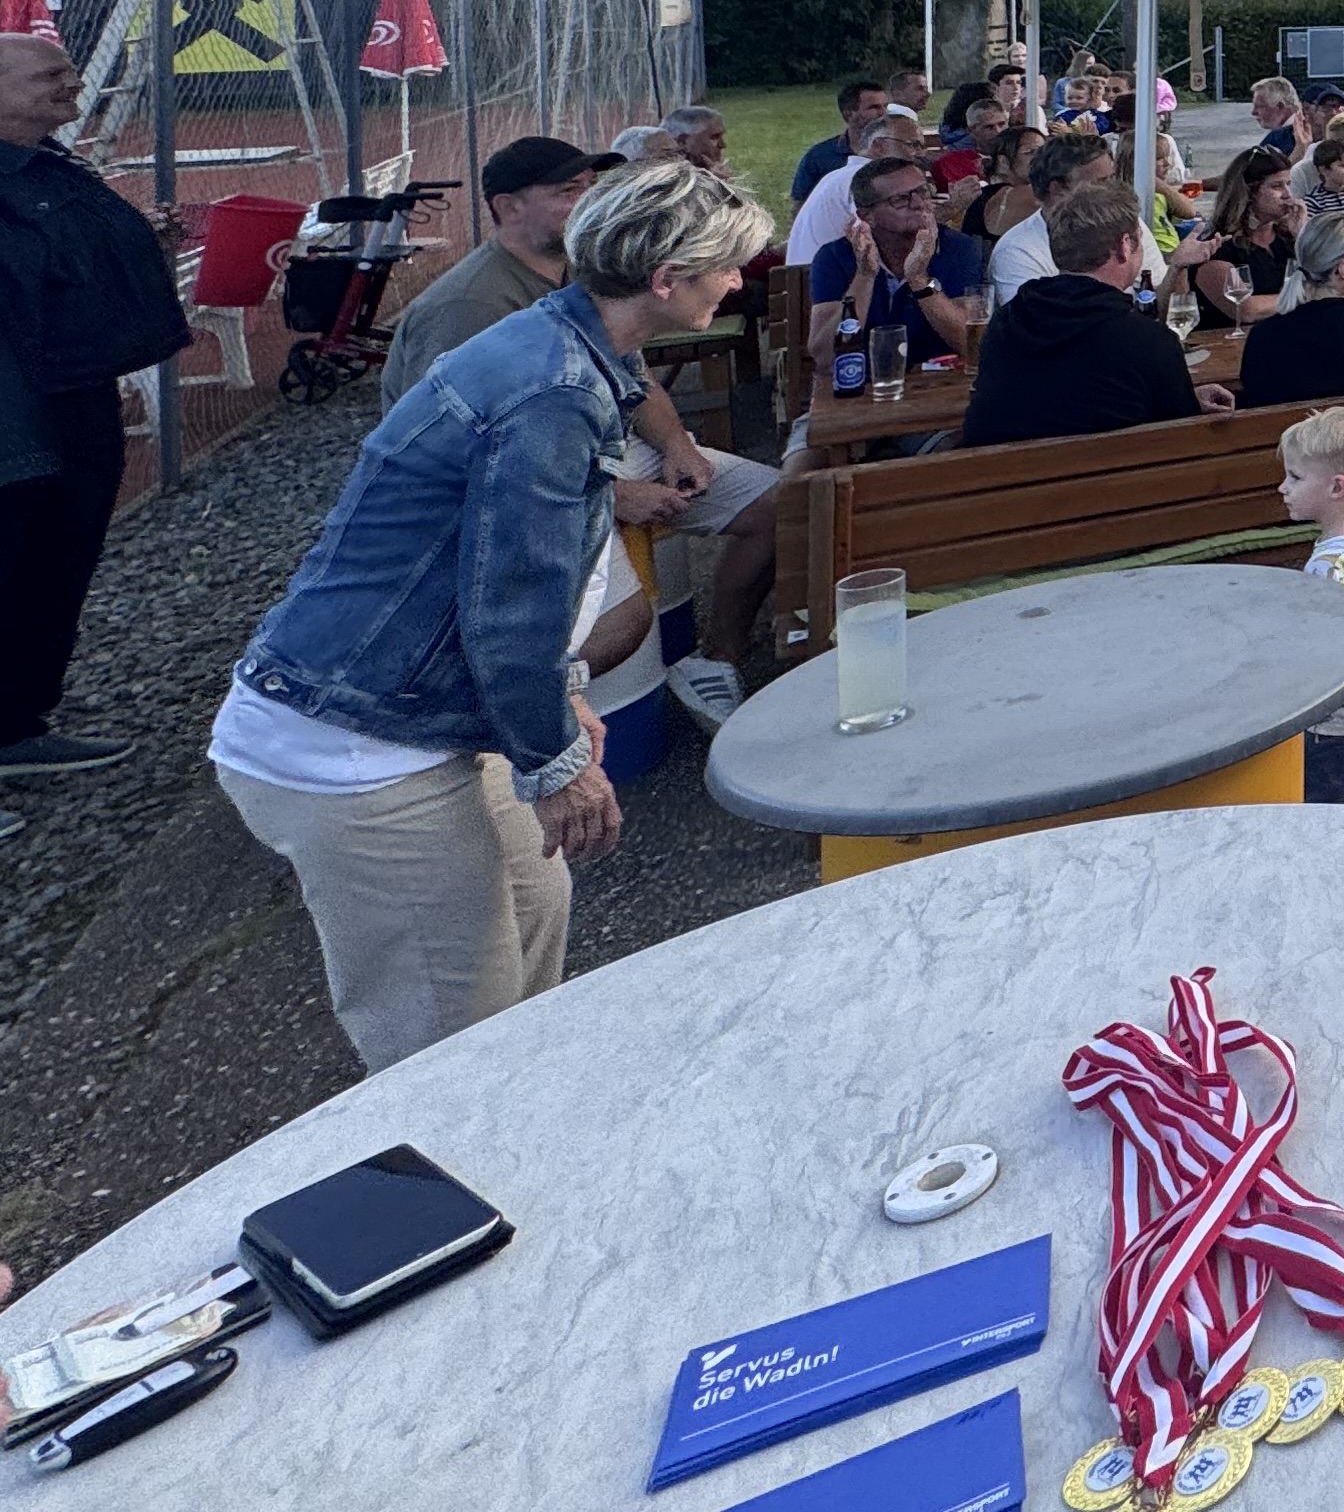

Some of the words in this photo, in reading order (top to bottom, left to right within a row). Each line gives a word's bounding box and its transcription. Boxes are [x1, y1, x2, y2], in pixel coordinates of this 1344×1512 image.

[972, 1316, 1036, 1343] INTERSPORT
[692, 1386, 736, 1411] die
[743, 1345, 840, 1393] Wadln!
[699, 1346, 796, 1390] Servus
